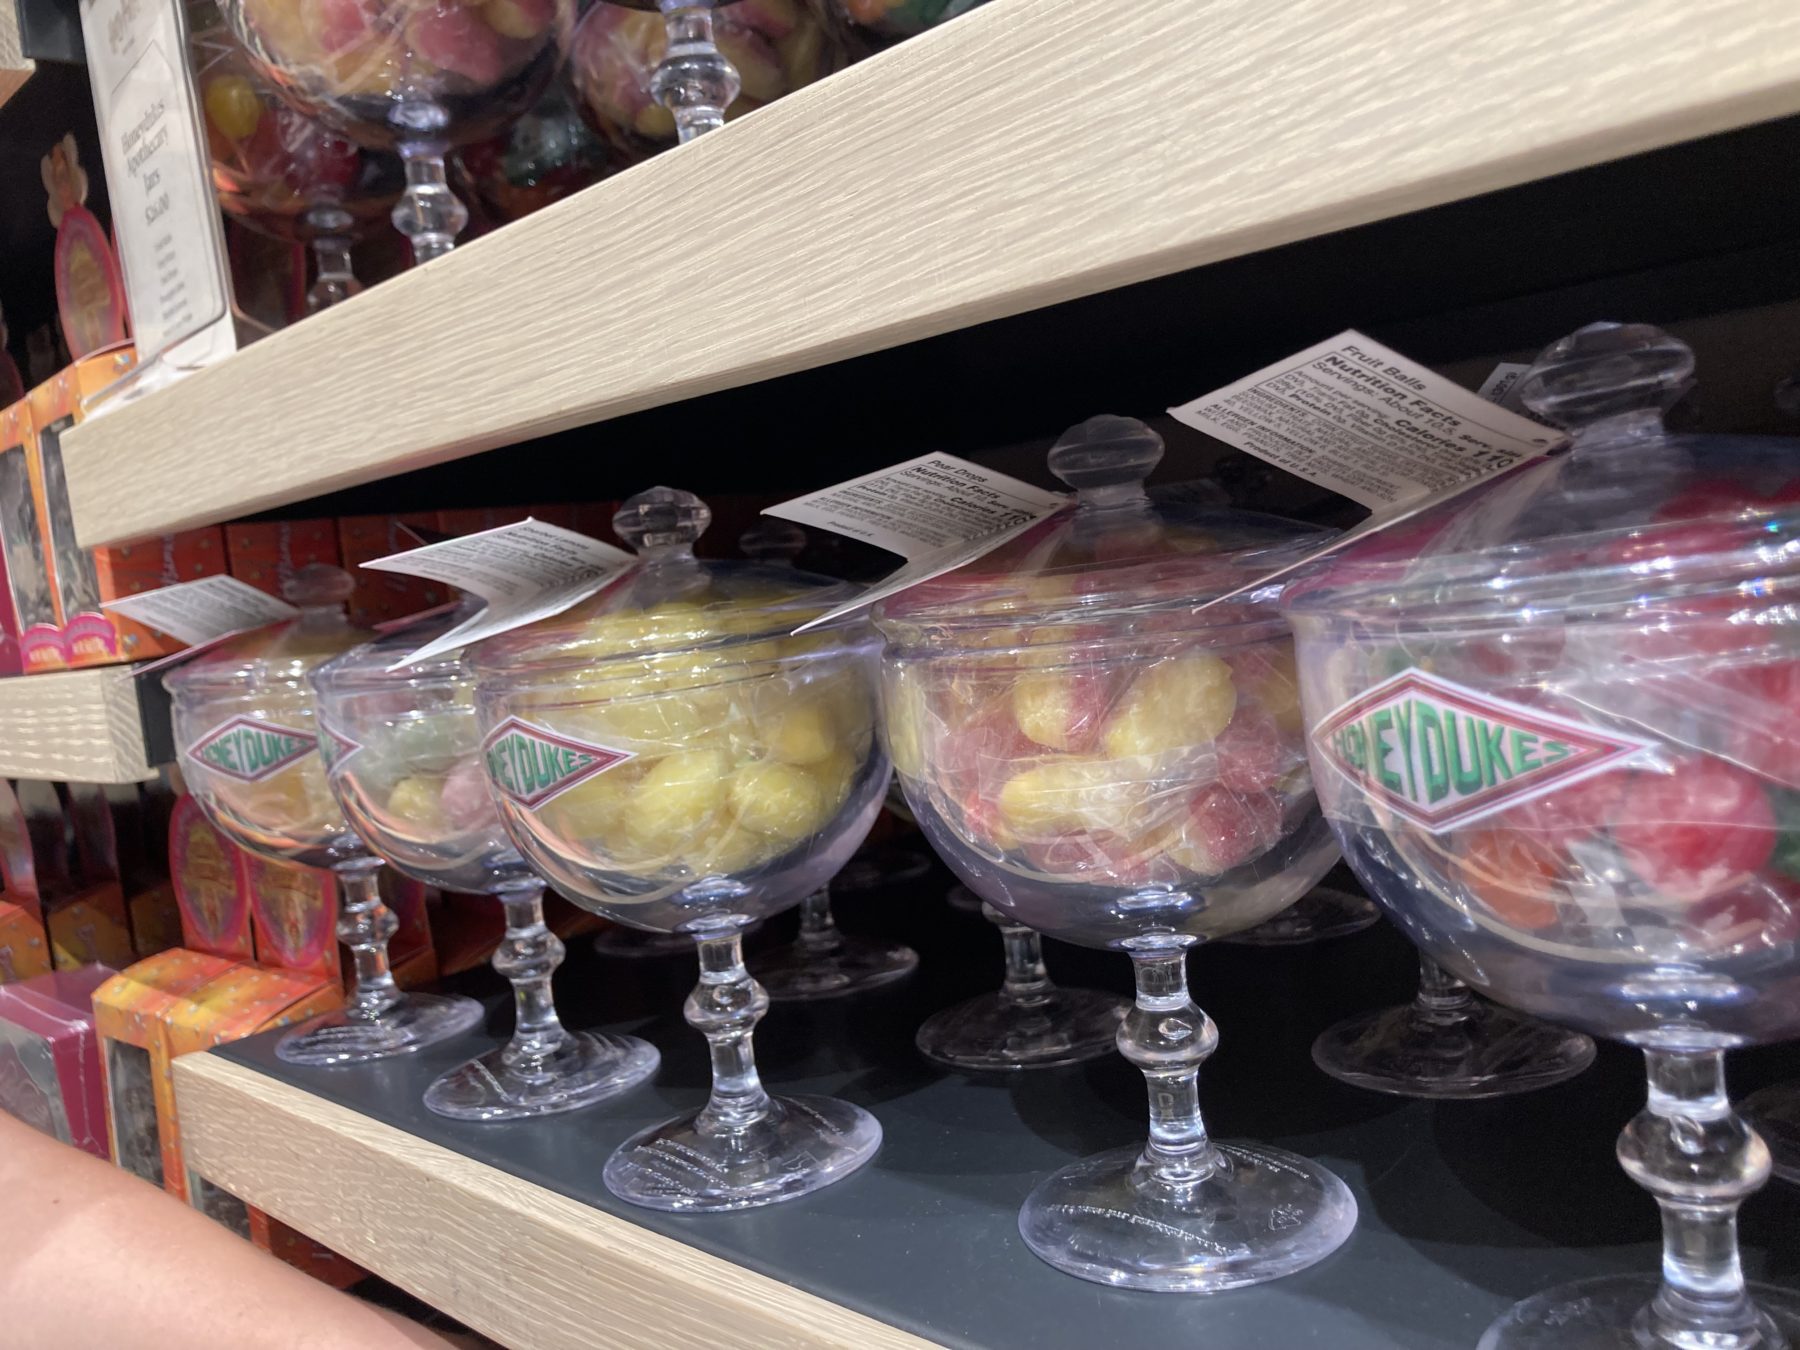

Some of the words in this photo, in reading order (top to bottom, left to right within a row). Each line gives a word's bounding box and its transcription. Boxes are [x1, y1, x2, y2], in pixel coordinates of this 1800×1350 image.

[127, 126, 168, 178] Apothecary
[1341, 345, 1384, 368] Fruit
[1383, 367, 1426, 390] Balls
[1289, 393, 1331, 416] Protein
[1312, 362, 1378, 396] Servings:
[1379, 397, 1424, 419] About
[1325, 356, 1407, 400] Nutrition
[1410, 400, 1461, 426] Facts
[1395, 419, 1465, 452] Calories
[912, 467, 966, 487] Nutrition
[966, 485, 1000, 499] Facts
[927, 459, 956, 471] Pear
[954, 468, 988, 483] Drops
[486, 734, 594, 796] NEYDUKES
